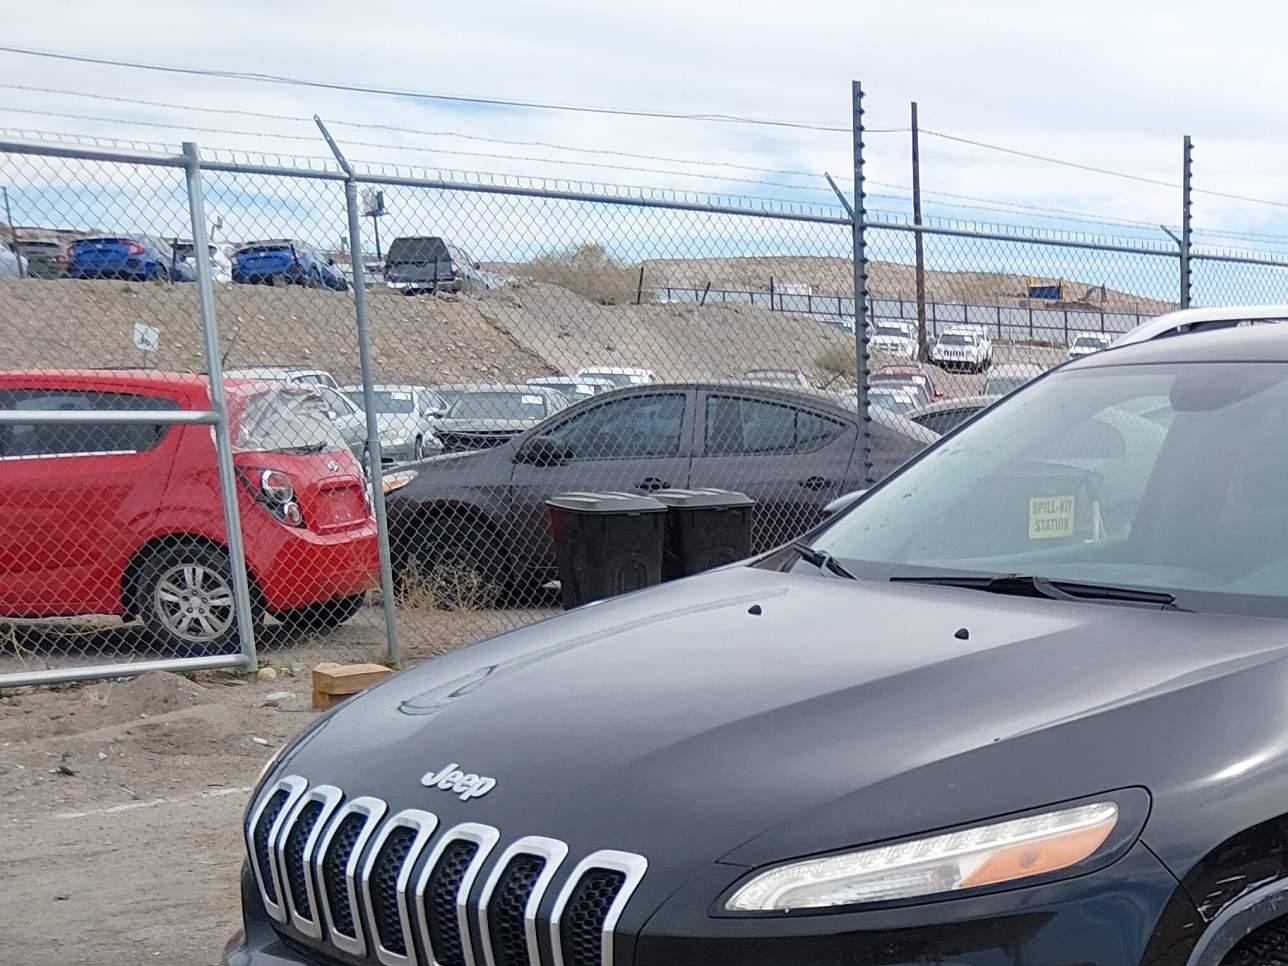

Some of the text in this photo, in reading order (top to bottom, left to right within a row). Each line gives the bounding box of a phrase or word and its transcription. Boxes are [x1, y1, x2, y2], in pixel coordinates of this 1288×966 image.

[1032, 500, 1073, 515] SPILL-KIT
[1034, 518, 1070, 532] STATION
[420, 762, 497, 801] Jeep
